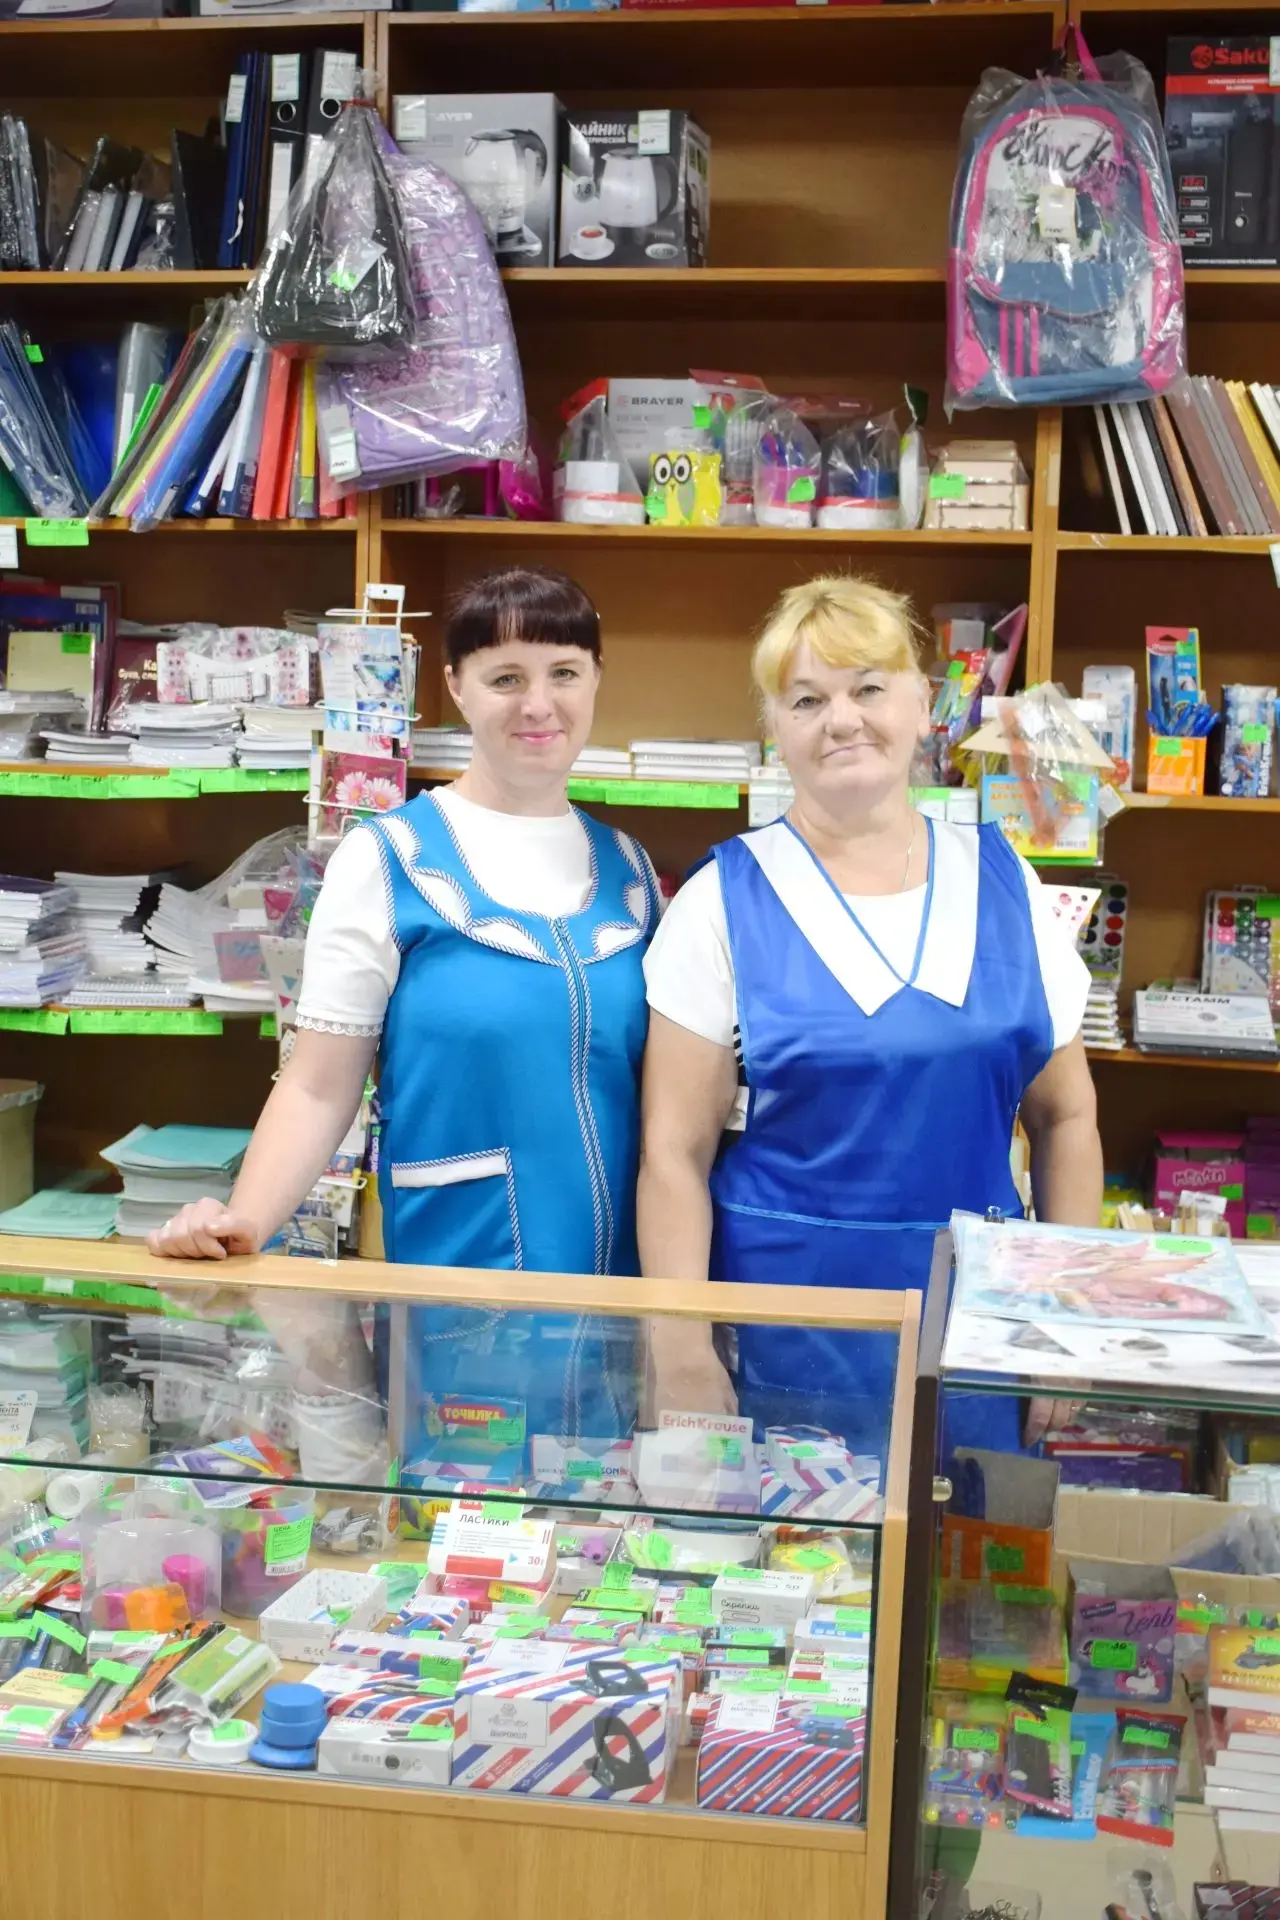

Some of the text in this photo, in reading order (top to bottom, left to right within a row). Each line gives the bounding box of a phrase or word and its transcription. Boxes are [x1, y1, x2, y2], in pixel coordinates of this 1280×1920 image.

[631, 396, 684, 406] BRAYER
[1172, 994, 1231, 1004] СТАММ
[444, 1407, 501, 1421] ТОЧИЛКА
[459, 1514, 510, 1527] ЛАСТИКИ
